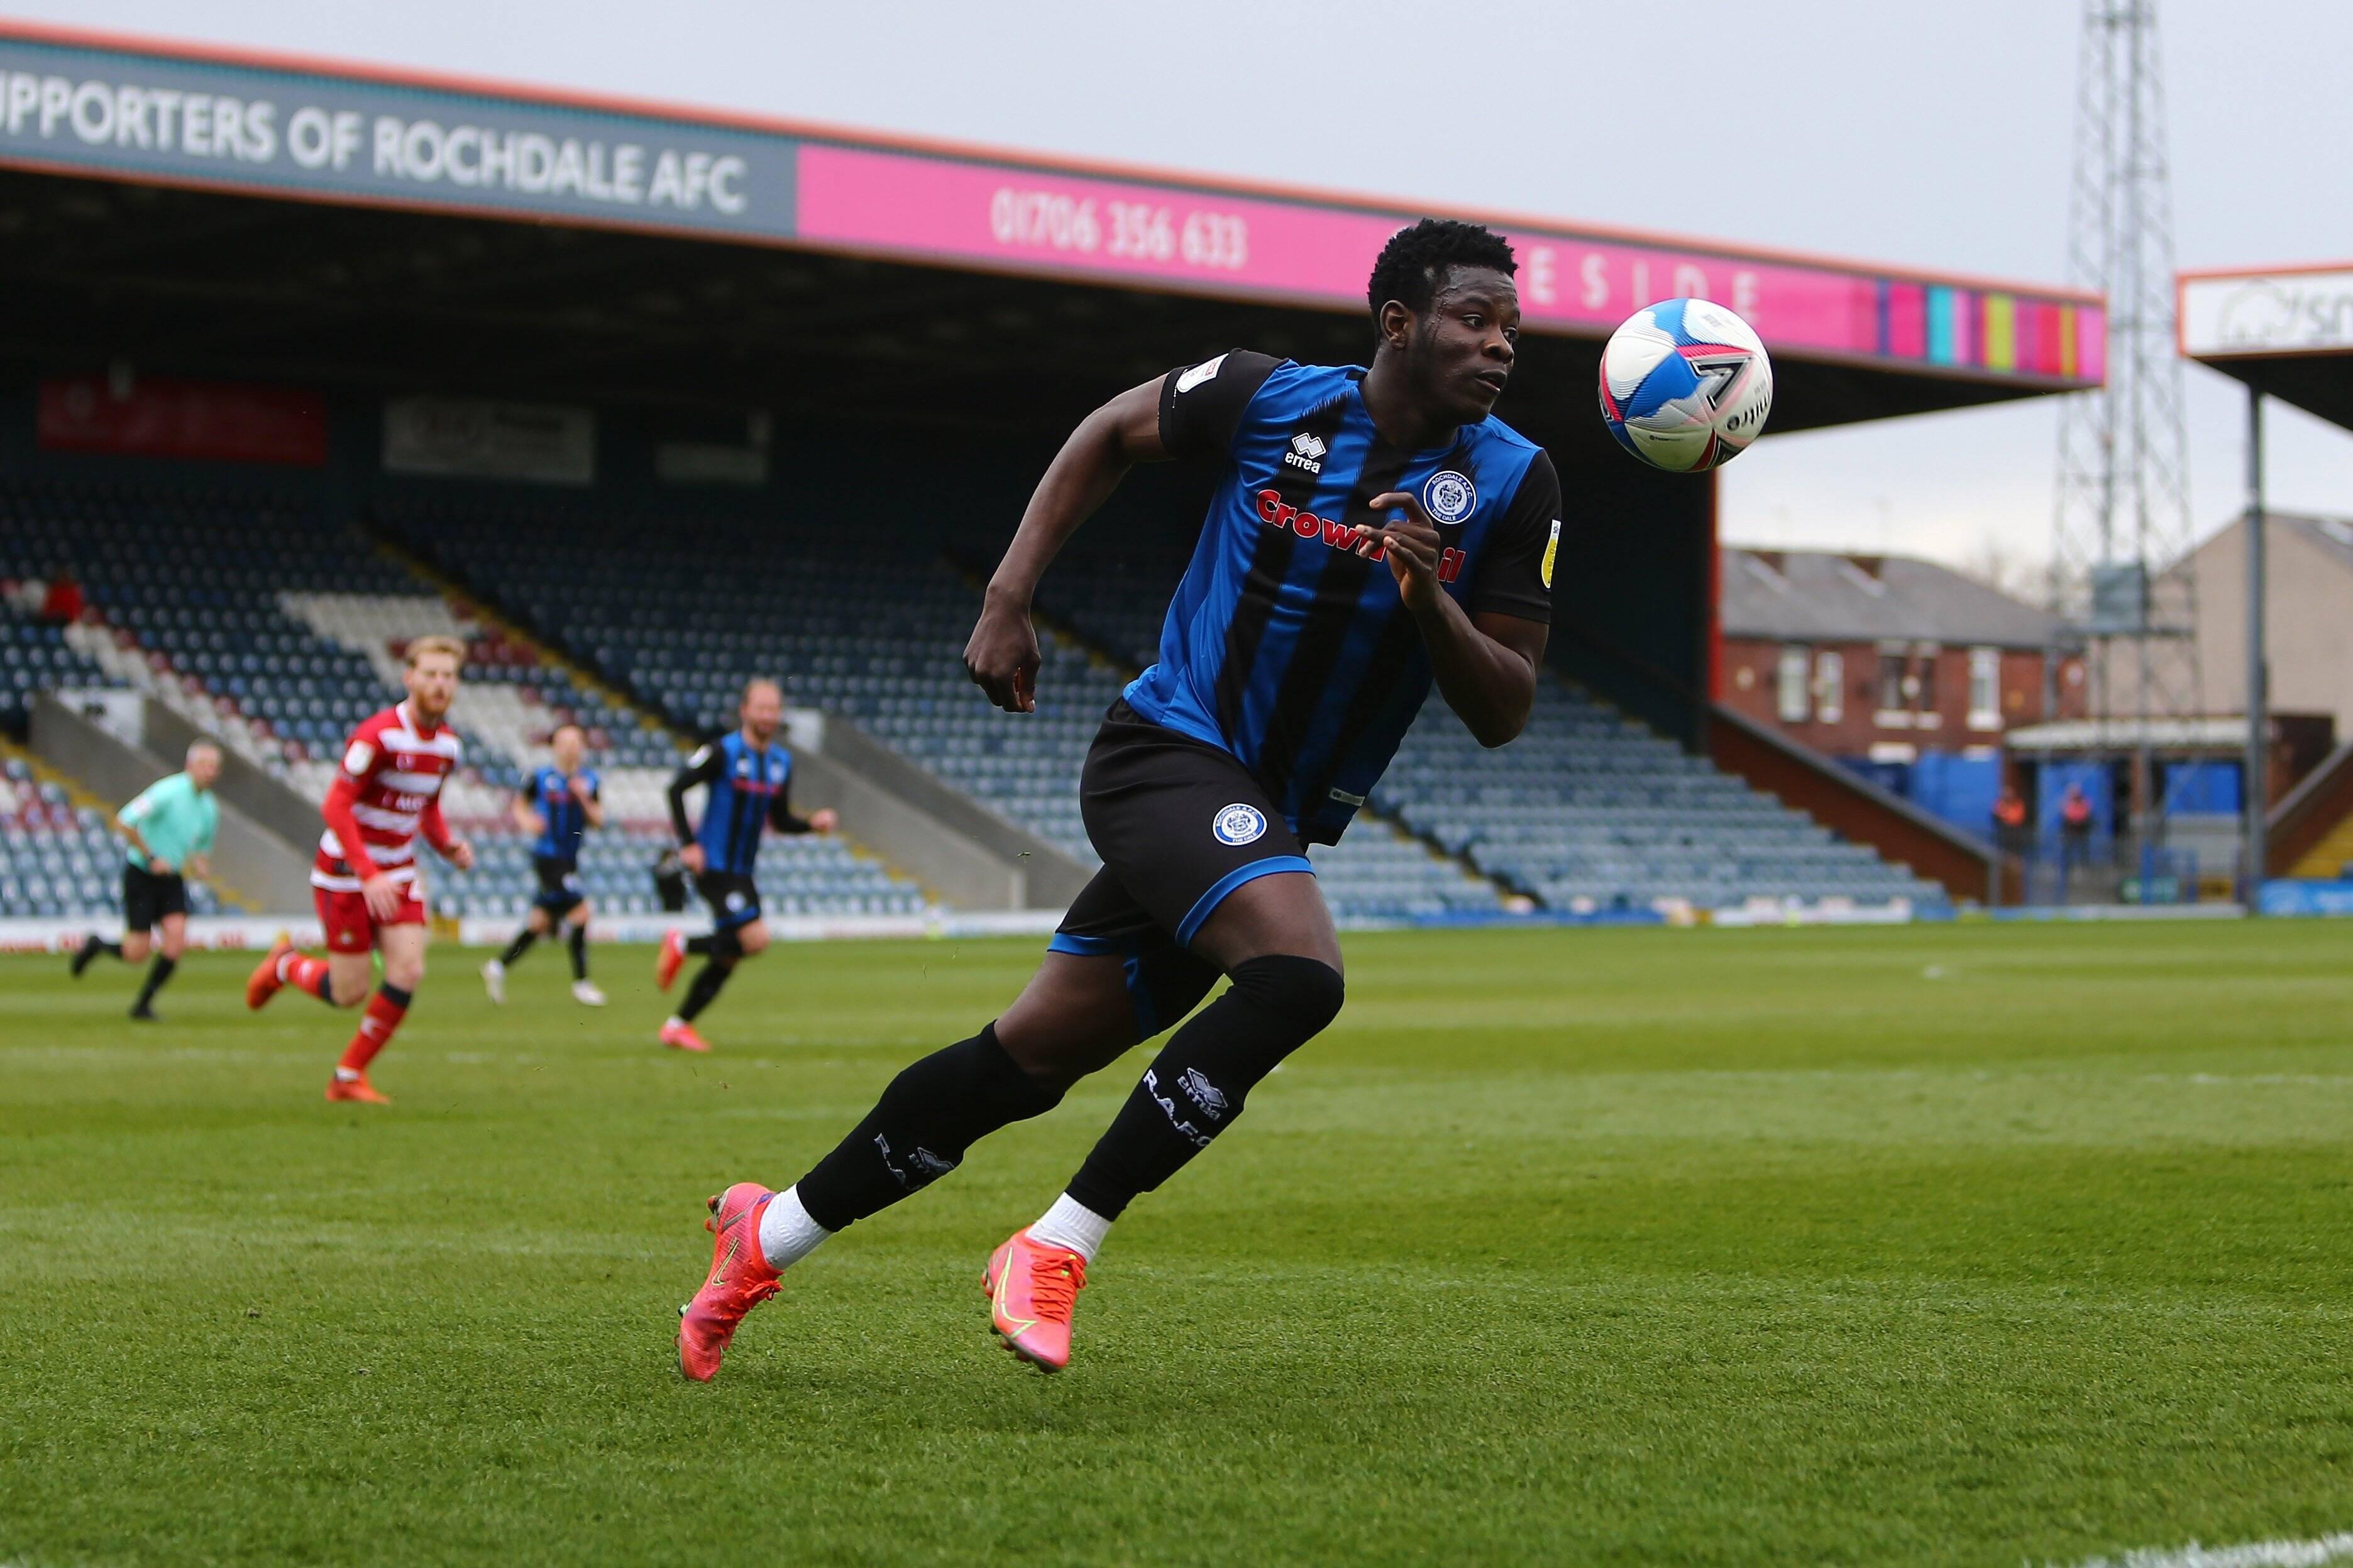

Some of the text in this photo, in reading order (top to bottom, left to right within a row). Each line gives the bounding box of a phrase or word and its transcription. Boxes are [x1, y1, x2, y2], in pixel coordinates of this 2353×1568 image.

[287, 106, 363, 172] OF
[373, 114, 646, 205] ROCHDALE
[649, 149, 747, 214] AFC
[990, 187, 1248, 271] 01706 356 633
[1526, 246, 1761, 327] ESIDE
[1284, 452, 1321, 474] errea
[1432, 474, 1463, 485] ROCHDALE
[1436, 547, 1466, 583] il
